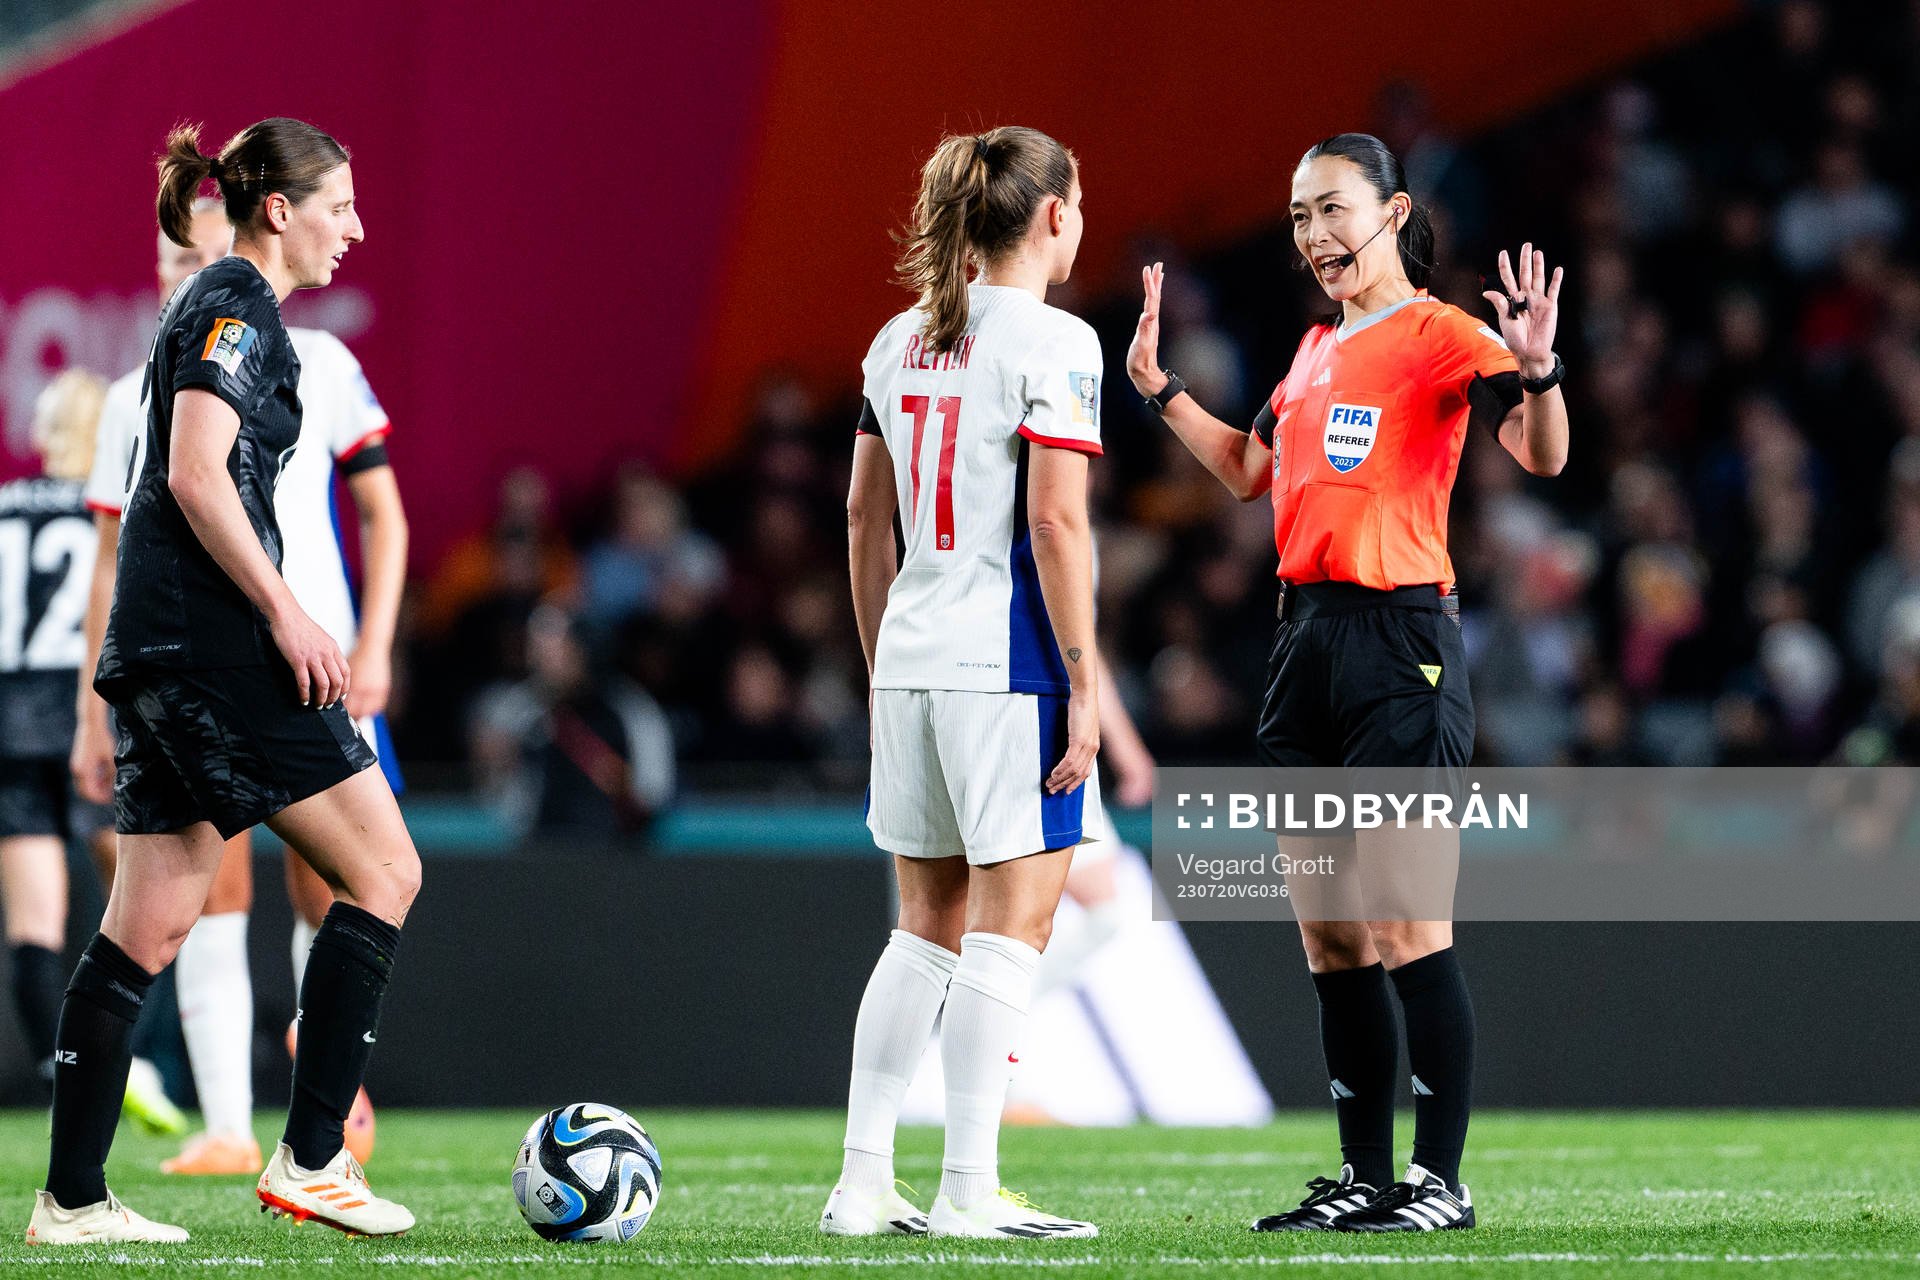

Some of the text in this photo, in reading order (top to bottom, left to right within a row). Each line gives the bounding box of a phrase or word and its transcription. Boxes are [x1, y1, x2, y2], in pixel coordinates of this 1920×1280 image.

[1332, 407, 1373, 427] FIFA
[1327, 434, 1370, 447] REFEREE
[1334, 457, 1354, 467] 2023
[901, 395, 962, 550] 11
[0, 516, 98, 673] 12
[55, 1049, 77, 1065] NZ
